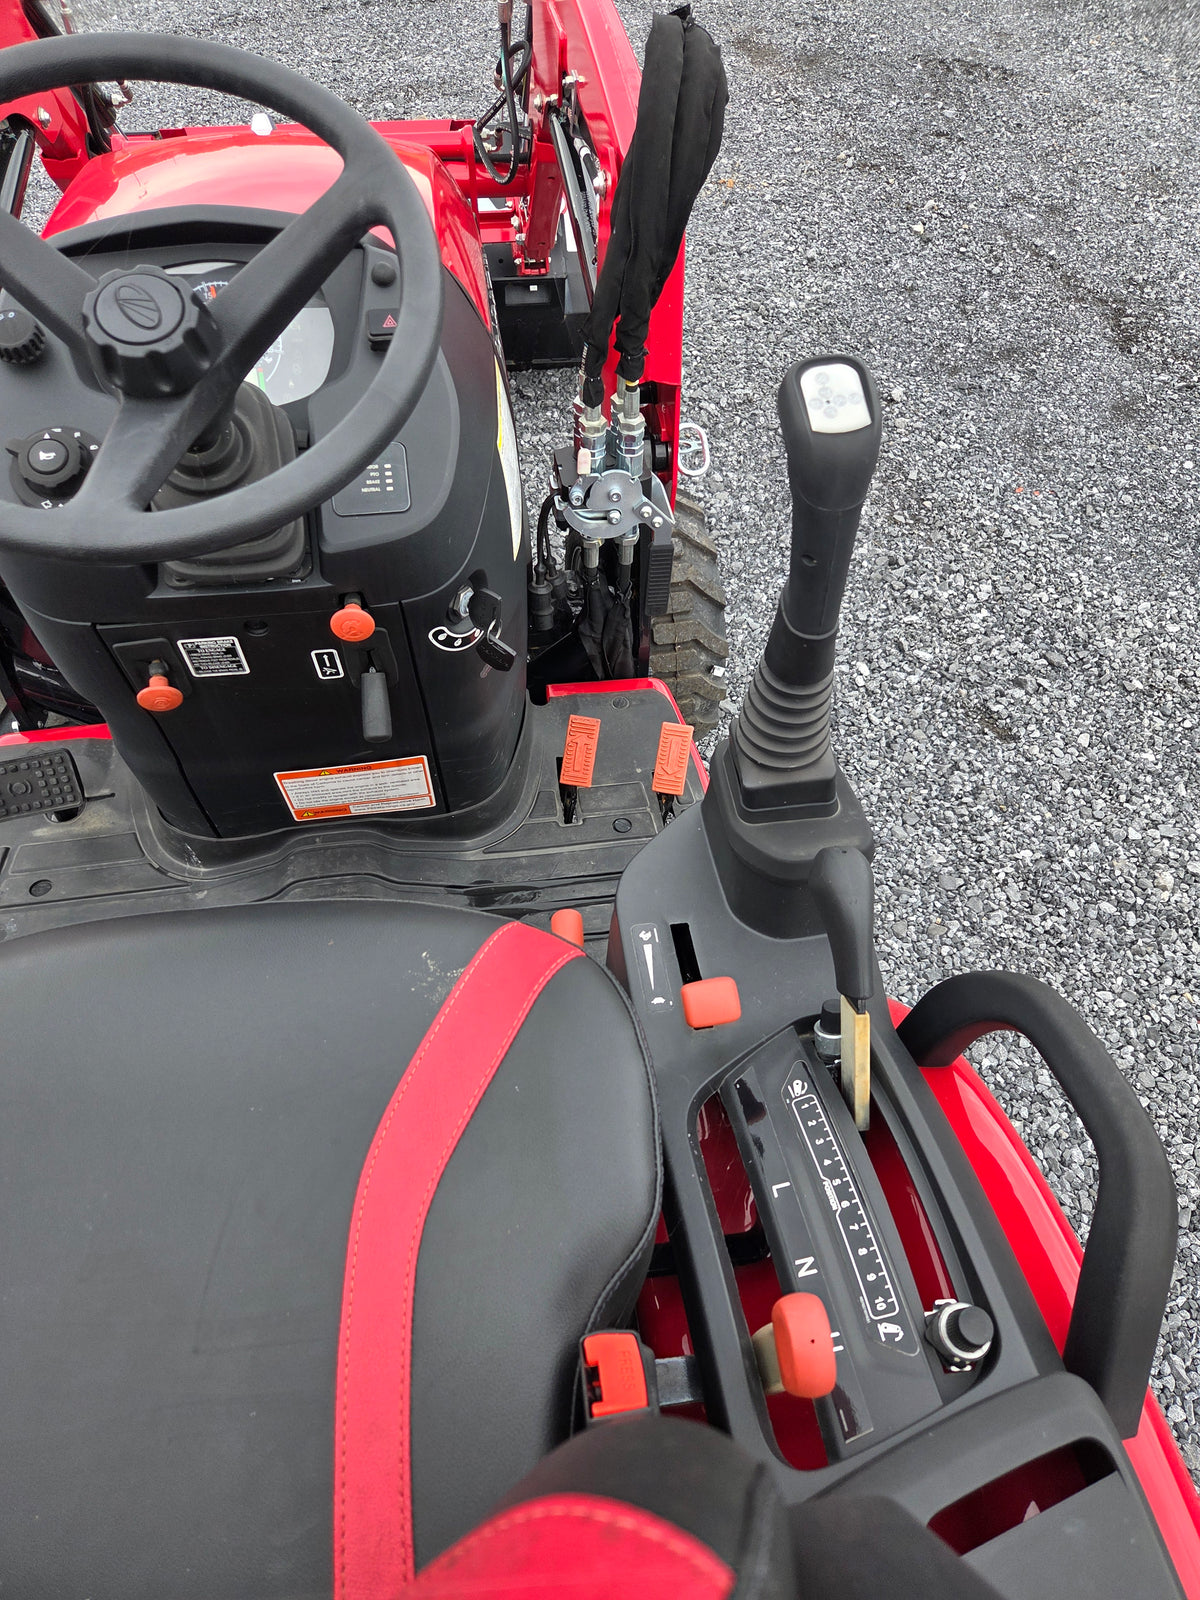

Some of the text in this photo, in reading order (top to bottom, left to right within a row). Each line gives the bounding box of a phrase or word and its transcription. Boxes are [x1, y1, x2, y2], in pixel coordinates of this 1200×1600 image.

[336, 765, 372, 774] WARNING
[771, 1181, 791, 1199] L
[822, 1181, 838, 1211] POSITION
[807, 1119, 817, 1127] 2
[815, 1137, 825, 1145] 3
[823, 1158, 833, 1166] 4
[832, 1178, 842, 1186] 5
[840, 1200, 851, 1209] 6
[849, 1222, 860, 1231] 7
[857, 1247, 868, 1256] 8
[866, 1272, 877, 1282] 9
[874, 1295, 887, 1311] 10
[794, 1256, 819, 1278] N
[618, 1350, 636, 1391] PRESS
